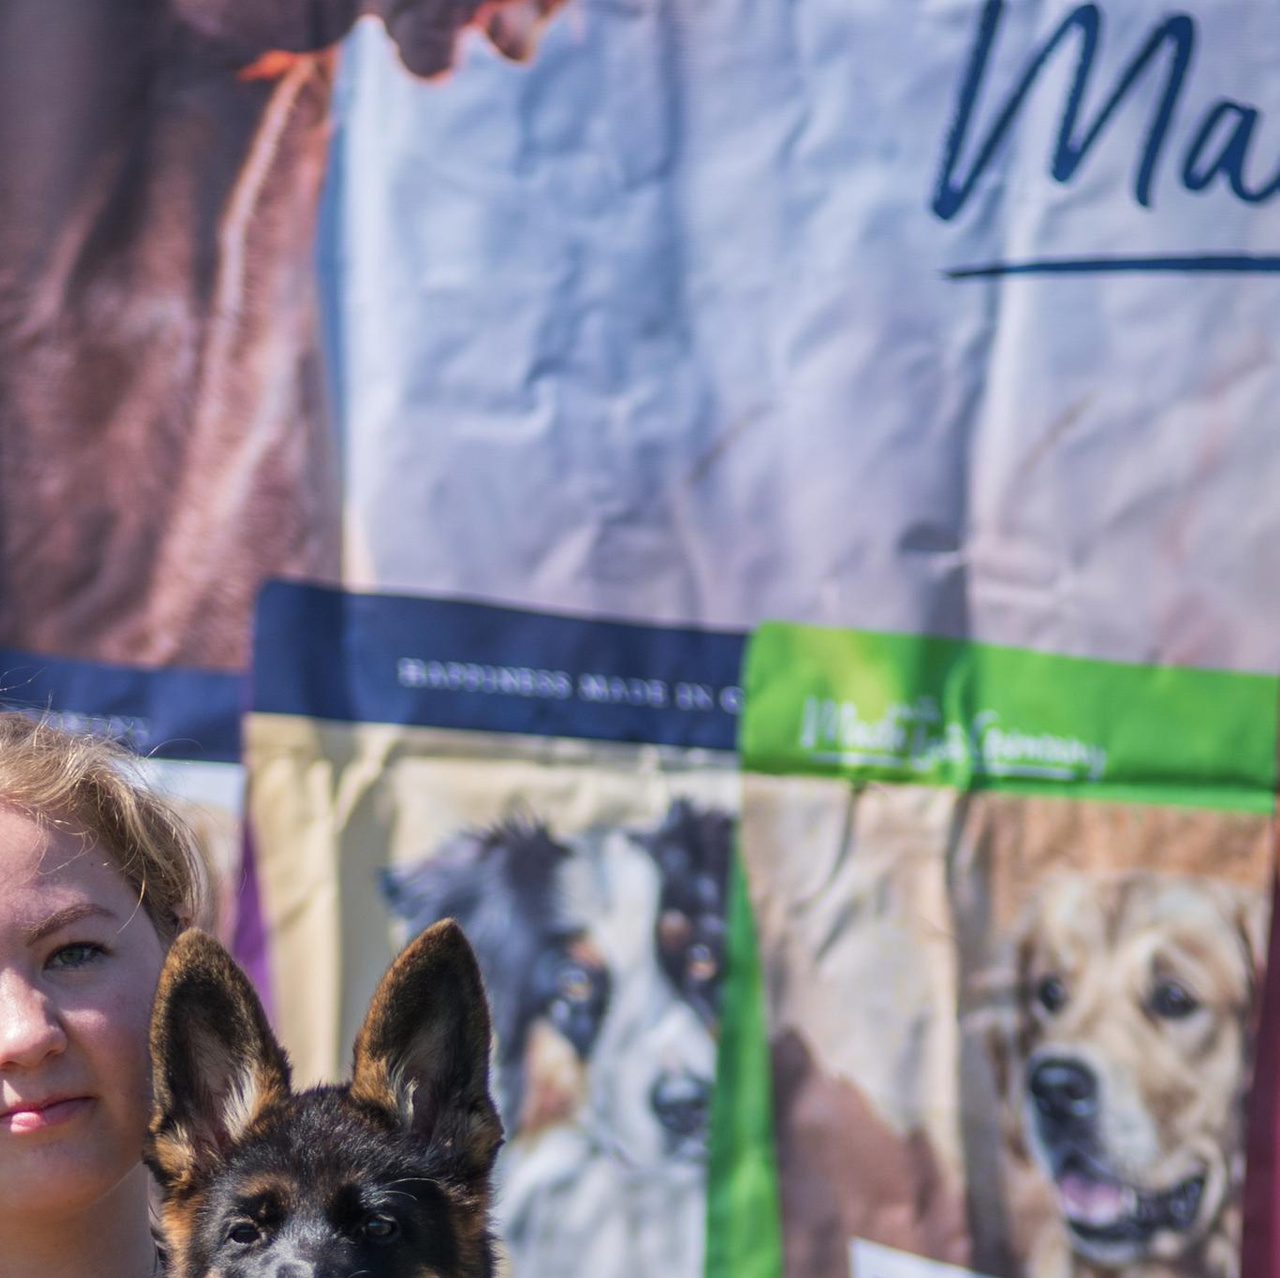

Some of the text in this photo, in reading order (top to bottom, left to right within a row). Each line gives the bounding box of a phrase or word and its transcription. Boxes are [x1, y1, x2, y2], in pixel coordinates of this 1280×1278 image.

[397, 658, 572, 699] HAPPINESS
[577, 673, 667, 709] MADE
[674, 682, 715, 712] IN
